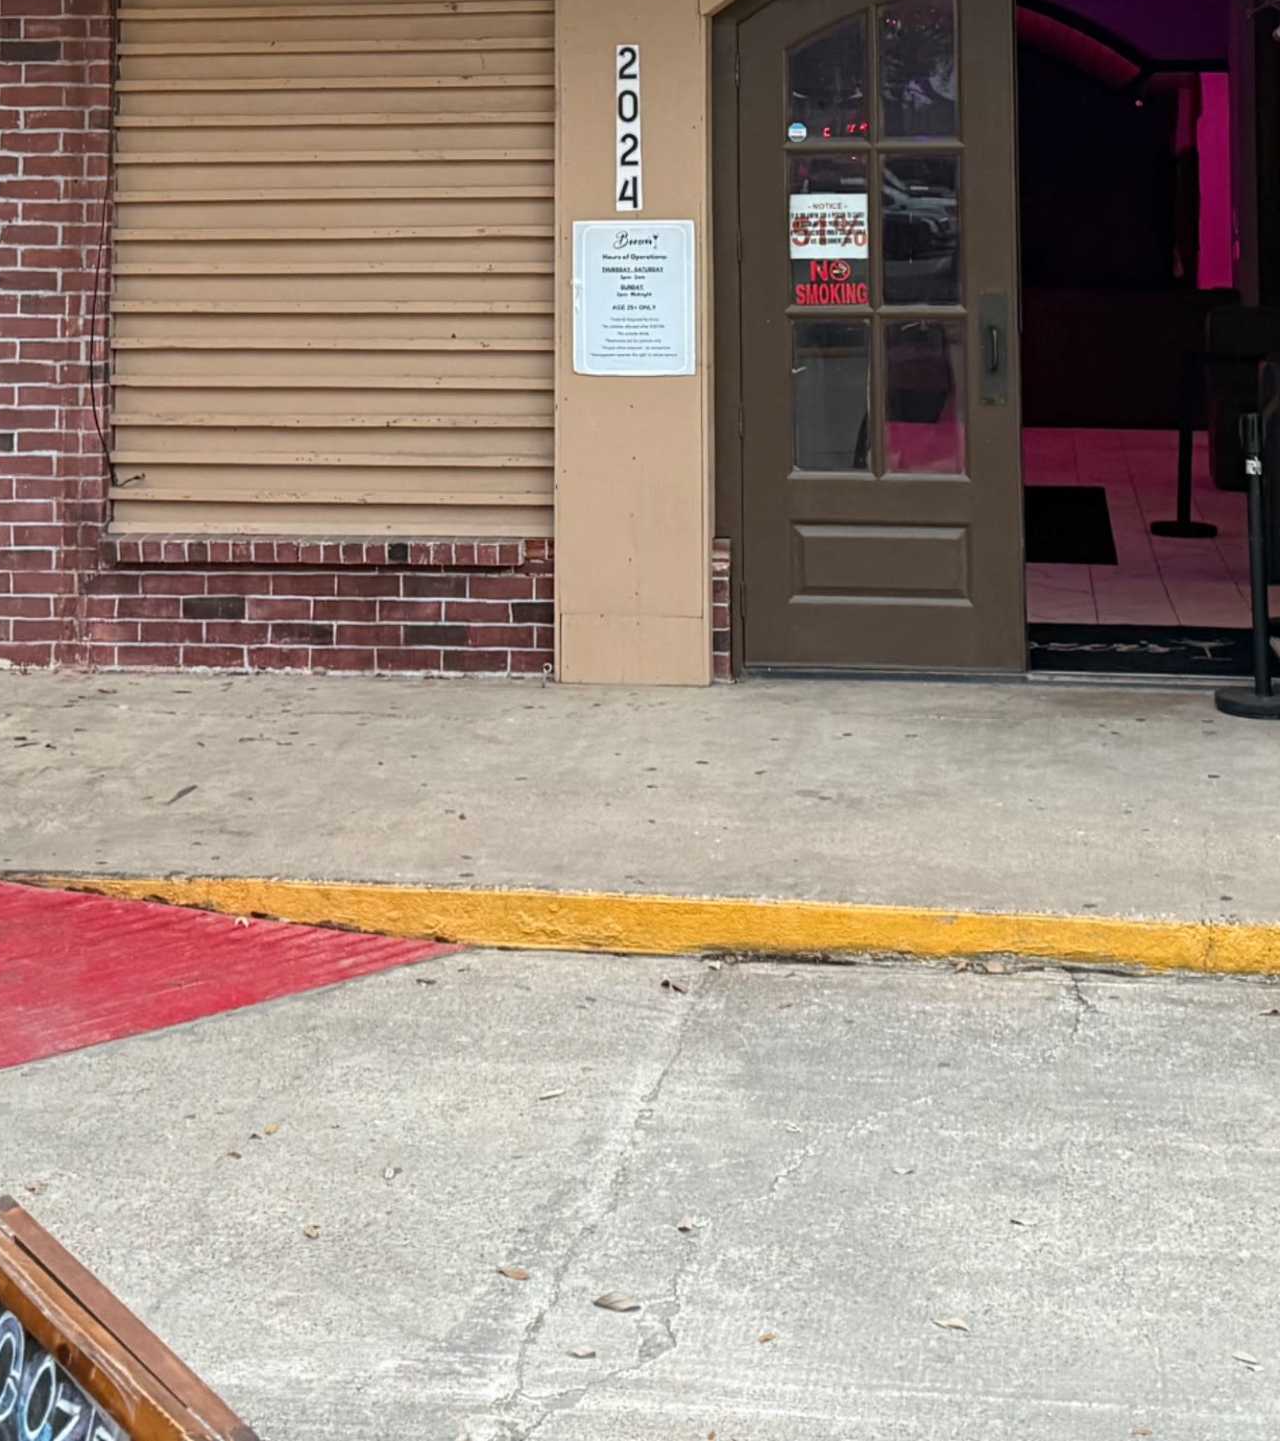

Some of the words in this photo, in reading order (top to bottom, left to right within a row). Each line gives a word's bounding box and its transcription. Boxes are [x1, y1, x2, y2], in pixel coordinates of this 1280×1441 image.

[618, 47, 639, 208] 2024
[812, 202, 843, 210] NOTICE
[791, 216, 868, 247] 51%
[795, 283, 869, 305] SMOKING
